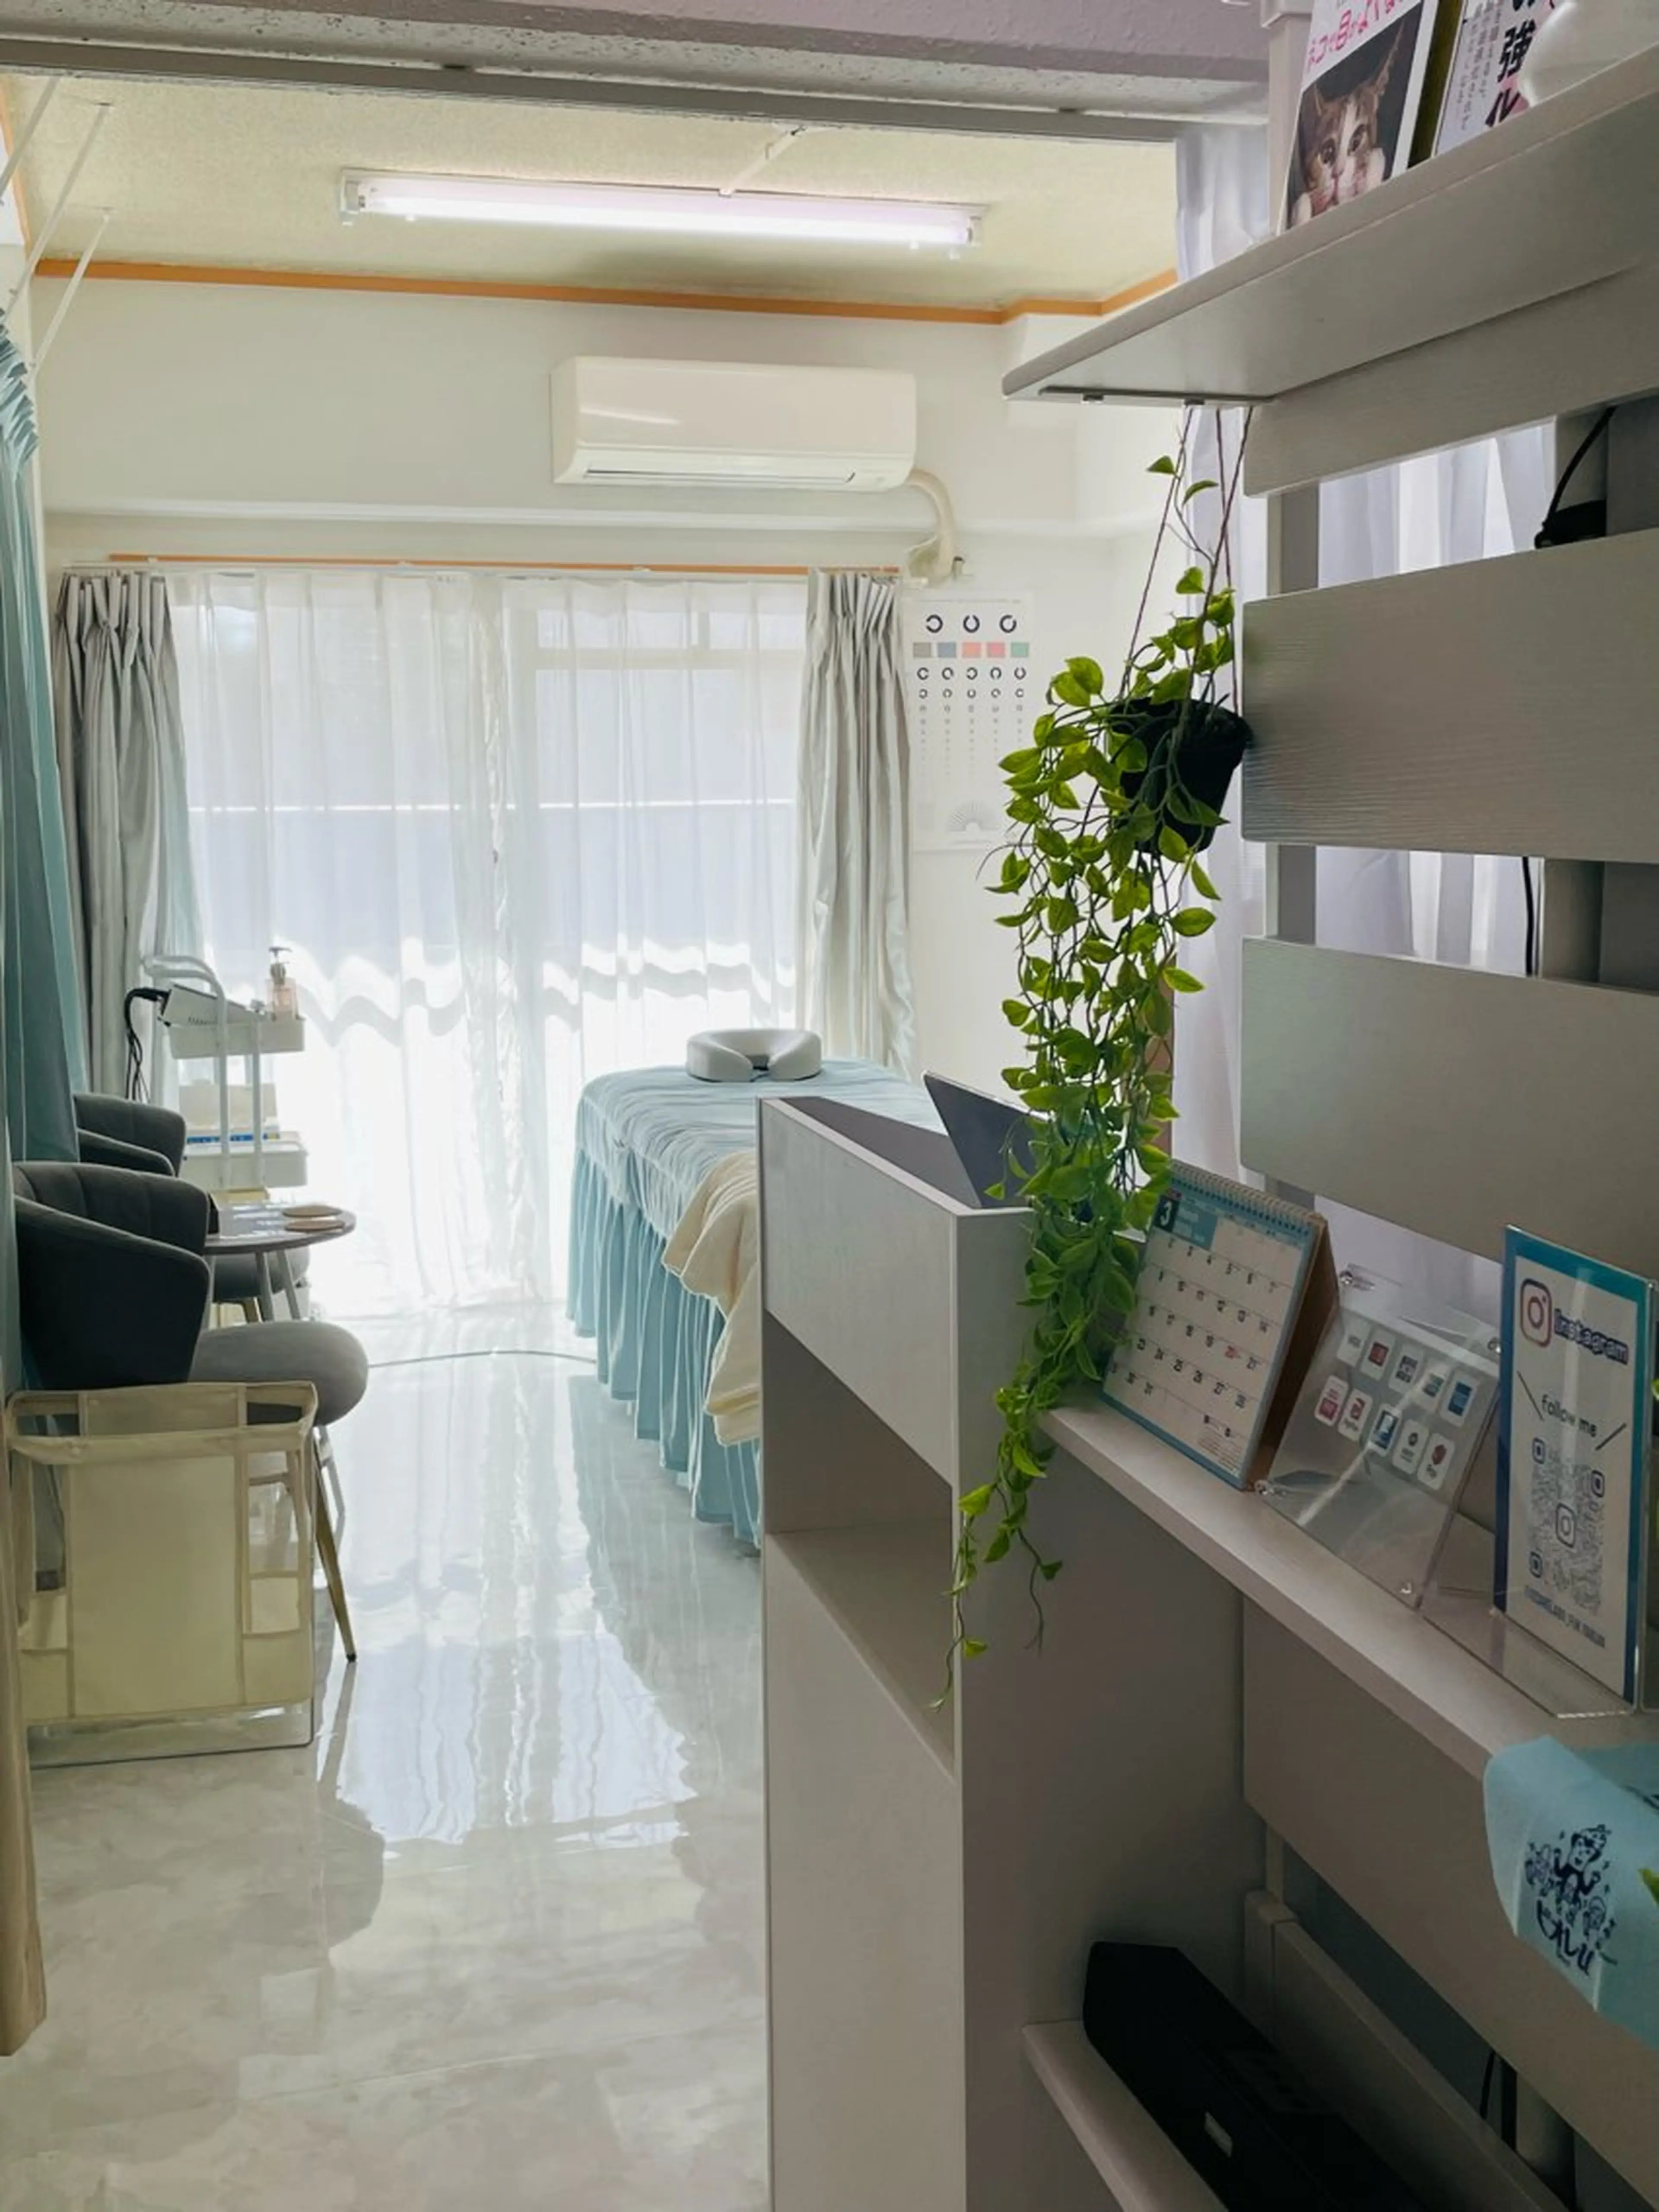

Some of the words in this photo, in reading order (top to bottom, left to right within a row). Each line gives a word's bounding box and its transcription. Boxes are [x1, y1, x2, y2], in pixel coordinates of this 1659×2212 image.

[1160, 1199, 1173, 1226] 3
[1554, 1308, 1629, 1365] Instagram
[1579, 1416, 1598, 1437] me
